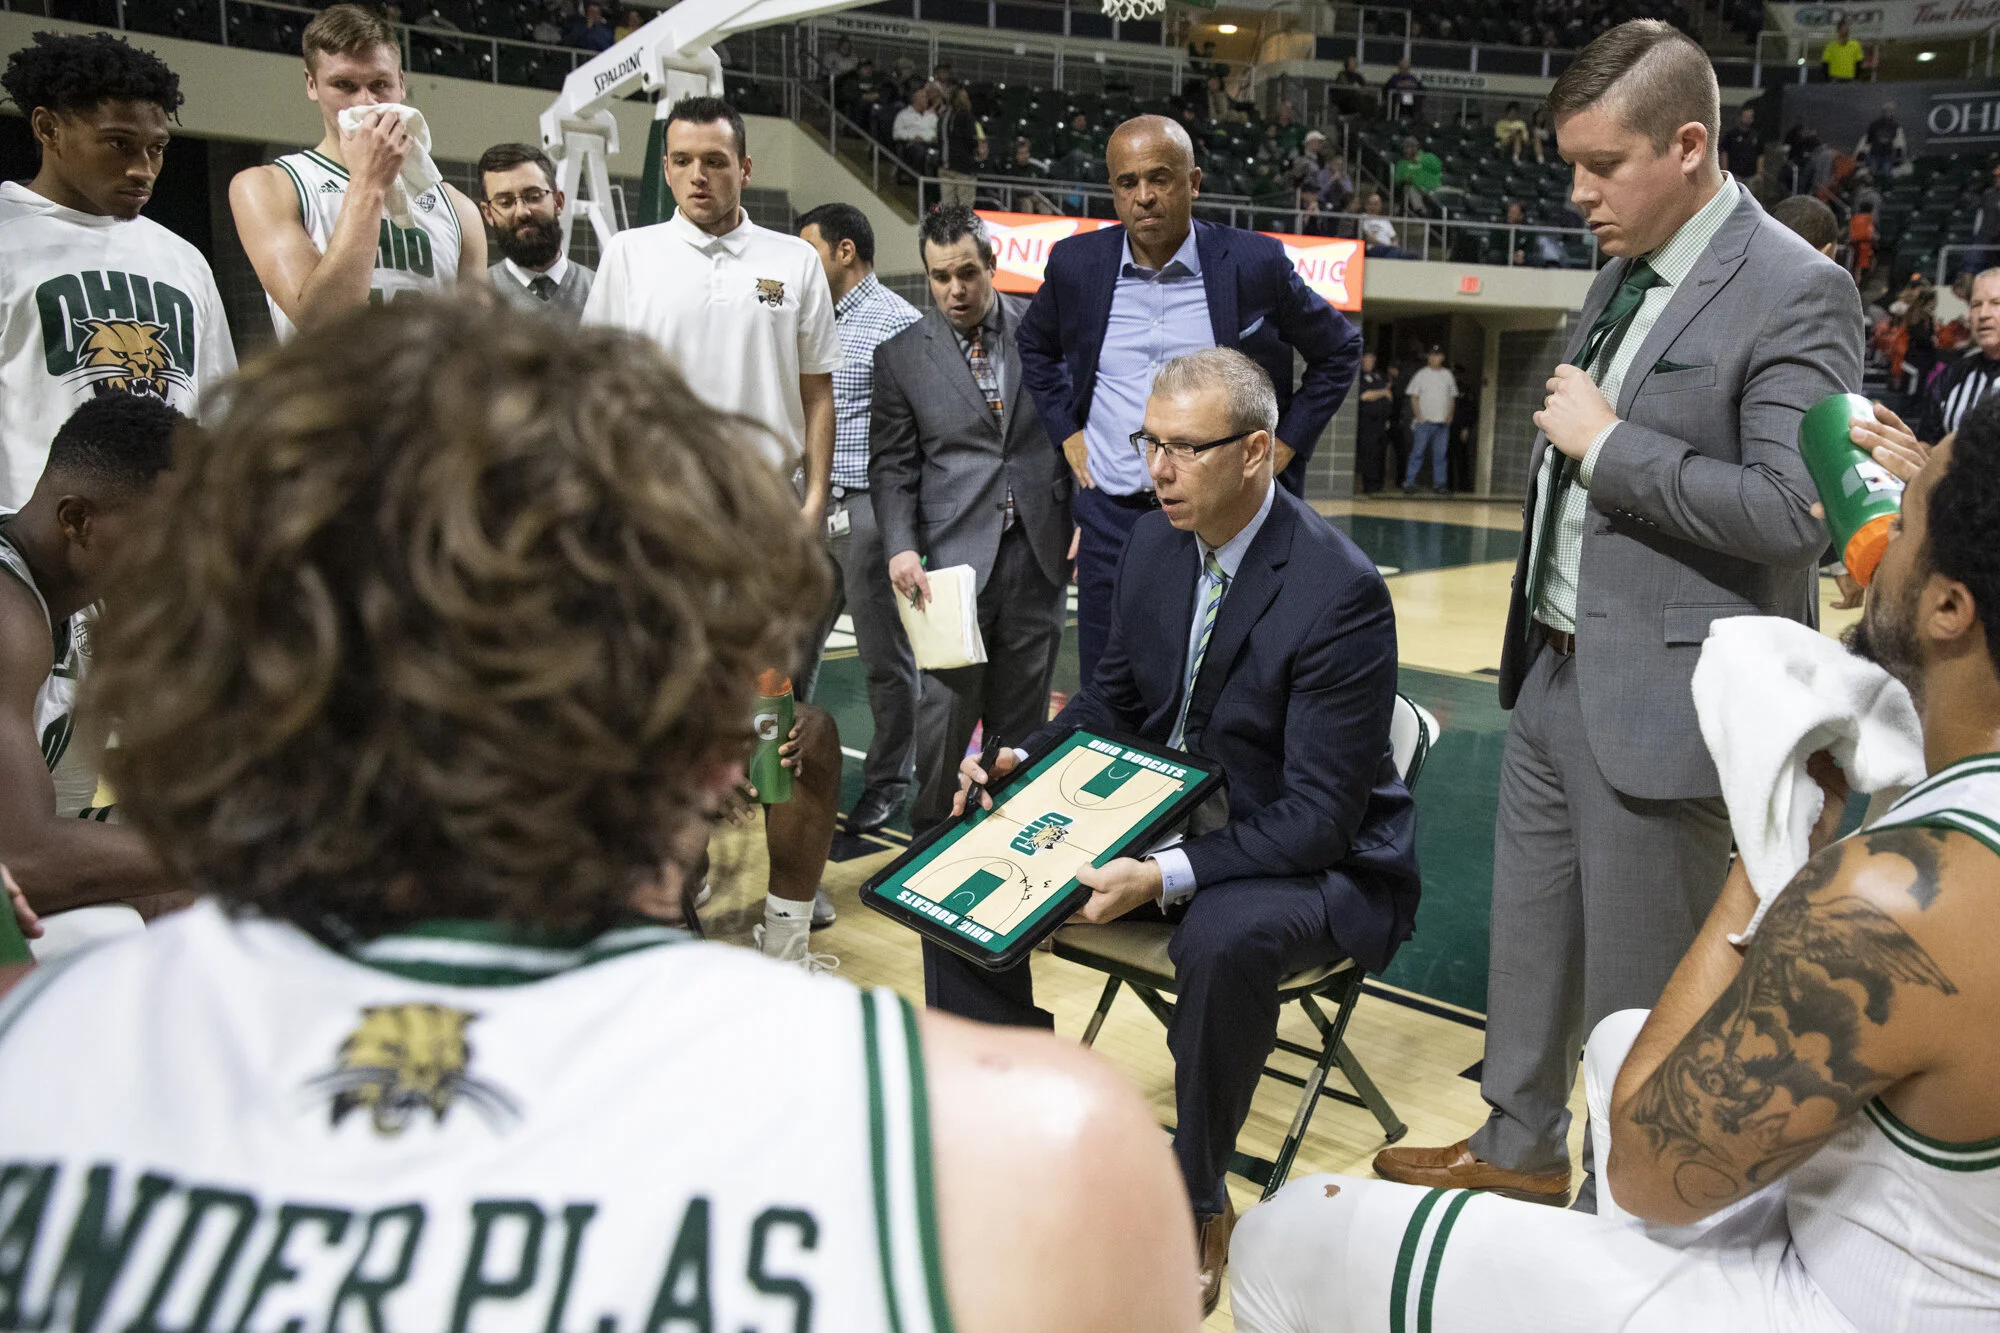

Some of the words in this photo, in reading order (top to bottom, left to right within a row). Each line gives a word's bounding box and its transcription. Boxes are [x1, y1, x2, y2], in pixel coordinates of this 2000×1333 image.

[836, 18, 911, 34] RESERVED
[1421, 73, 1485, 87] RESERVED
[36, 270, 195, 378] OHIO
[753, 713, 779, 741] G
[1087, 739, 1123, 757] OHIO
[1121, 751, 1188, 779] BOBCATS
[1009, 811, 1074, 857] OHIO
[896, 890, 960, 926] BOBCATS
[956, 919, 995, 943] OHIO
[0, 1162, 425, 1333] ANDER
